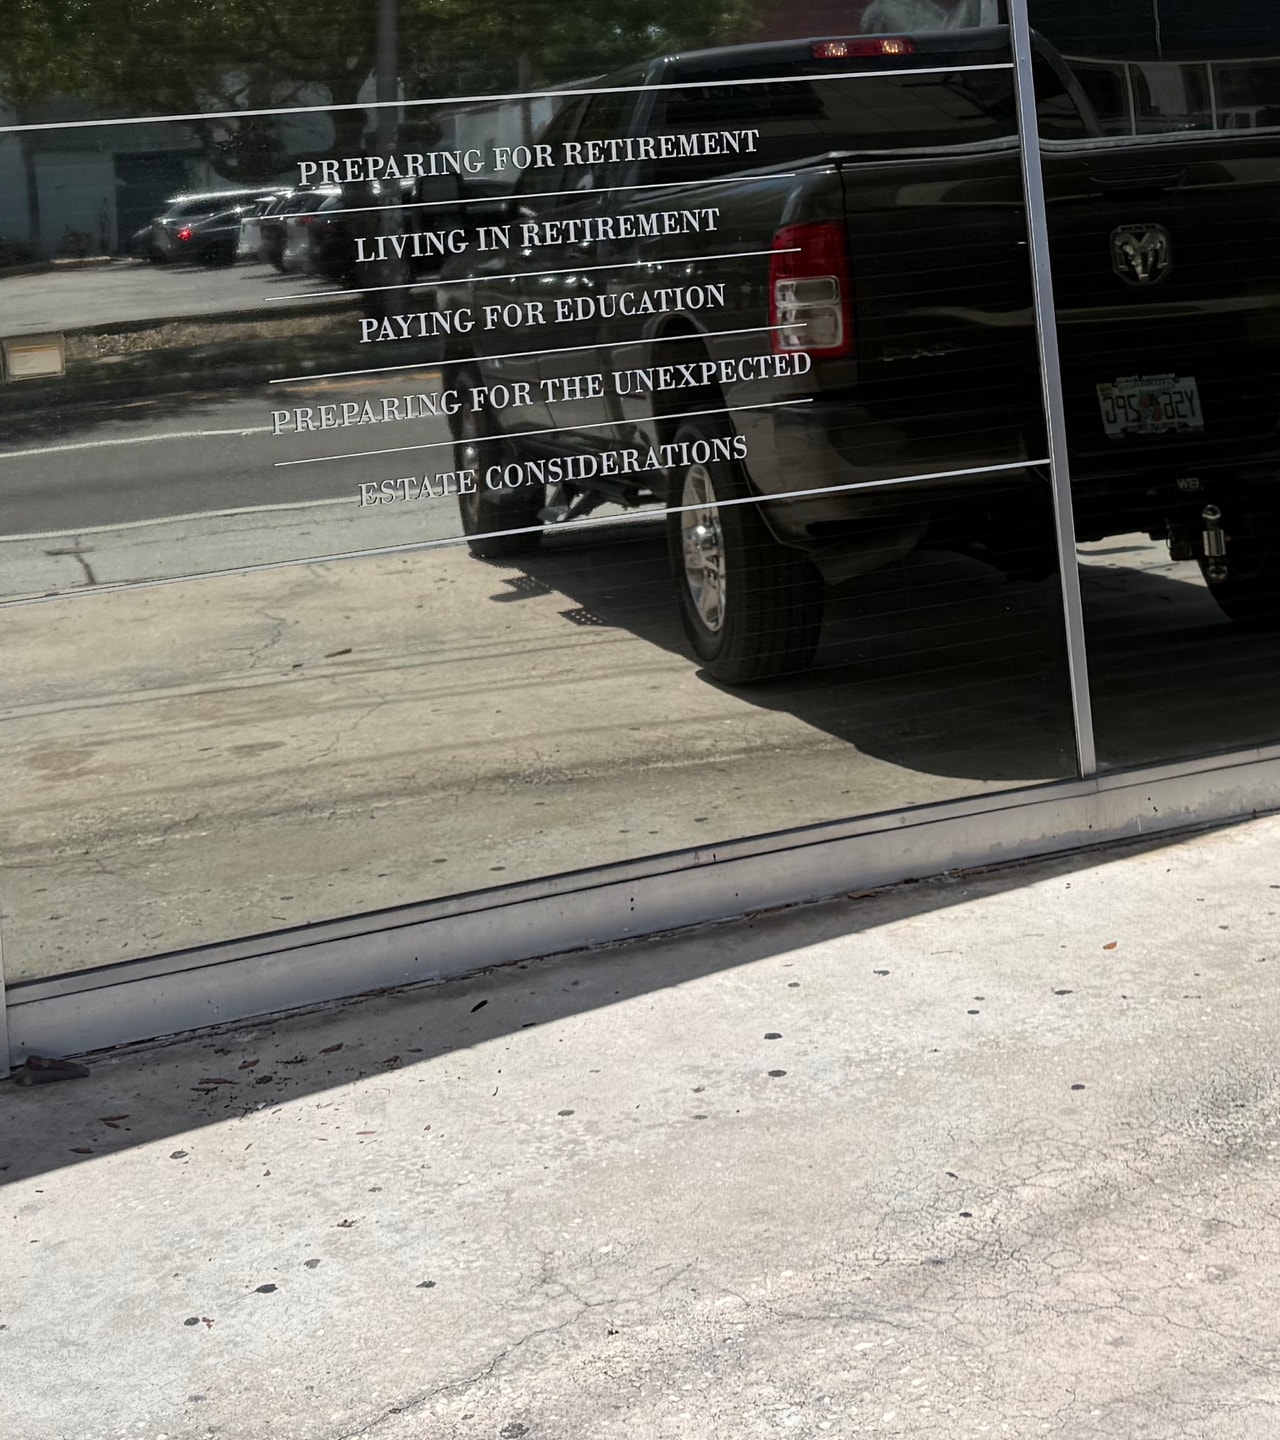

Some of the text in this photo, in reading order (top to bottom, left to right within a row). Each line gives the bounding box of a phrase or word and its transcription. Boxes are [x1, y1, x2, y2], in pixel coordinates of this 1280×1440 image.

[297, 128, 760, 187] PREPARING FOR RETIREMENT
[354, 208, 721, 263] LIVING IN RETIREMENT
[359, 283, 727, 344] PAYING FOR EDUCATION
[271, 351, 813, 436] PREPARING FOR THE UNEXPECTED
[357, 434, 749, 509] ESTATE CONSIDERATIONS
